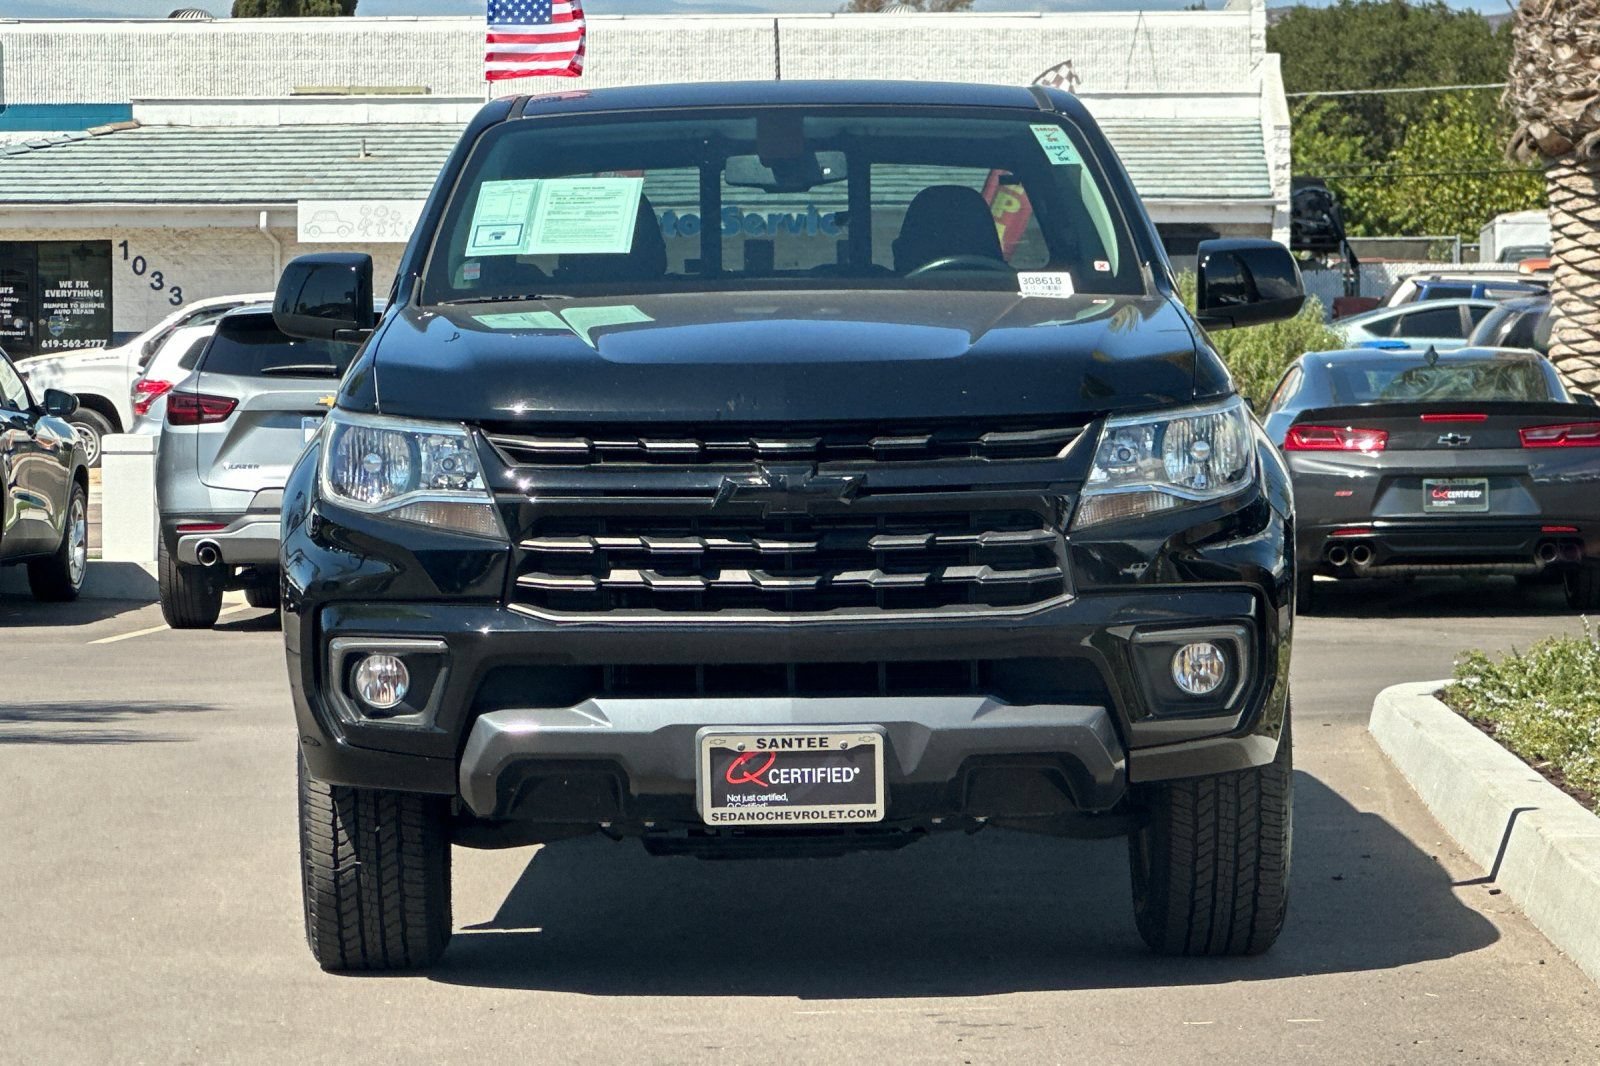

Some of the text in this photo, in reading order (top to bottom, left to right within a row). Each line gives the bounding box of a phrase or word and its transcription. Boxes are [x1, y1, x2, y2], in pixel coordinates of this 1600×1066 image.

[660, 208, 701, 238] to
[720, 203, 845, 238] Servic
[118, 240, 184, 306] 1033
[44, 290, 104, 298] EVERYTHING!
[41, 340, 107, 348] 619-562-2777
[756, 737, 829, 749] SANTEE
[726, 792, 789, 803] Not just certified,
[711, 809, 878, 822] SEDANOCHEVROLET.COM
